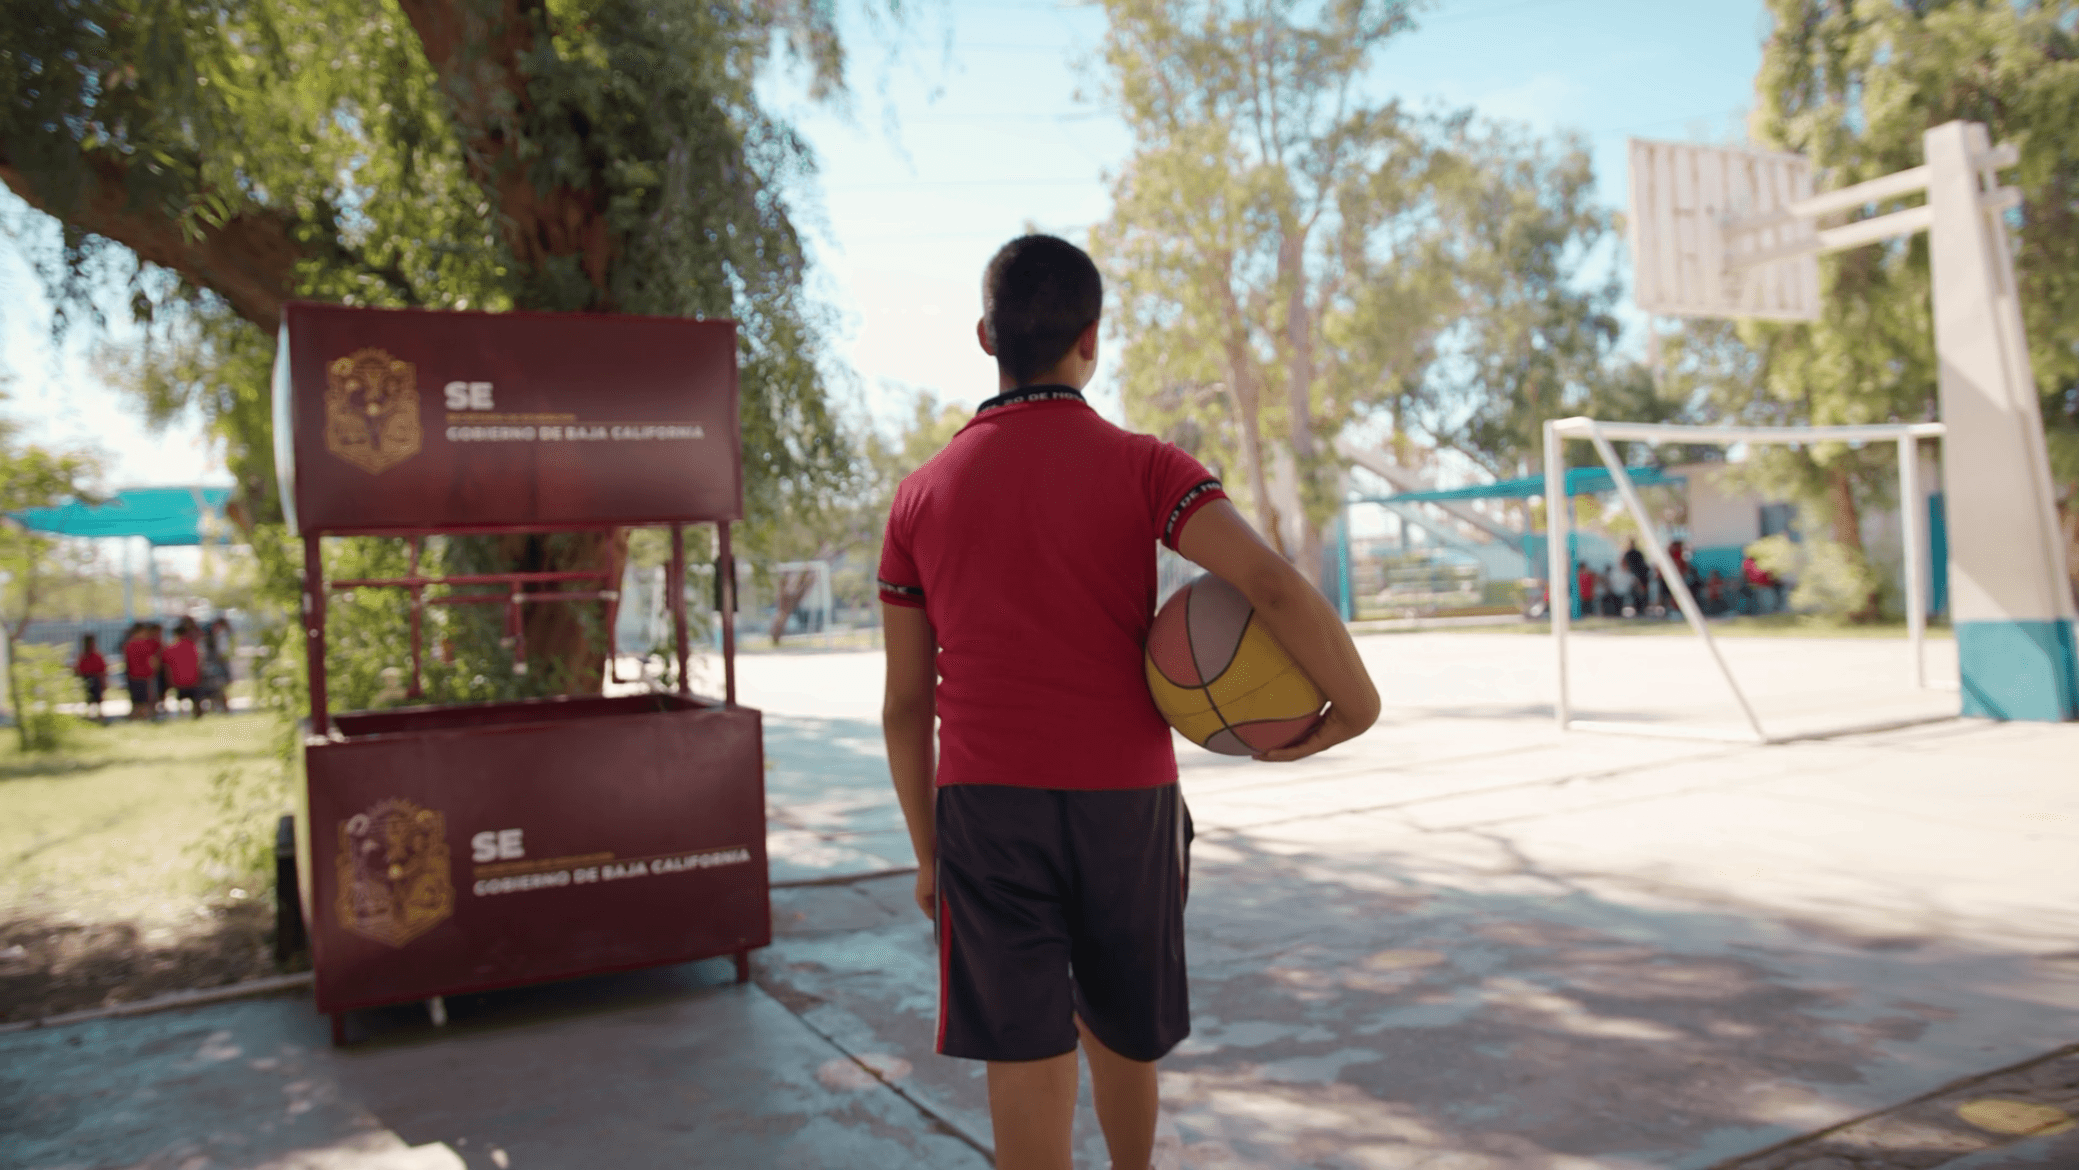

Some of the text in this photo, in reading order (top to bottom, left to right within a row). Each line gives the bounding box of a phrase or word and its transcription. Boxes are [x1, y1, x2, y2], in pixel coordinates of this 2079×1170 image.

[445, 381, 494, 410] SE
[446, 426, 704, 441] GOBIERNO DE BAJA CALIFORNIA
[472, 828, 525, 862] SE
[473, 870, 571, 896] GOBIERNO
[573, 866, 599, 884] DE
[601, 861, 649, 881] BAJA
[650, 848, 750, 874] CALIFORNIA
